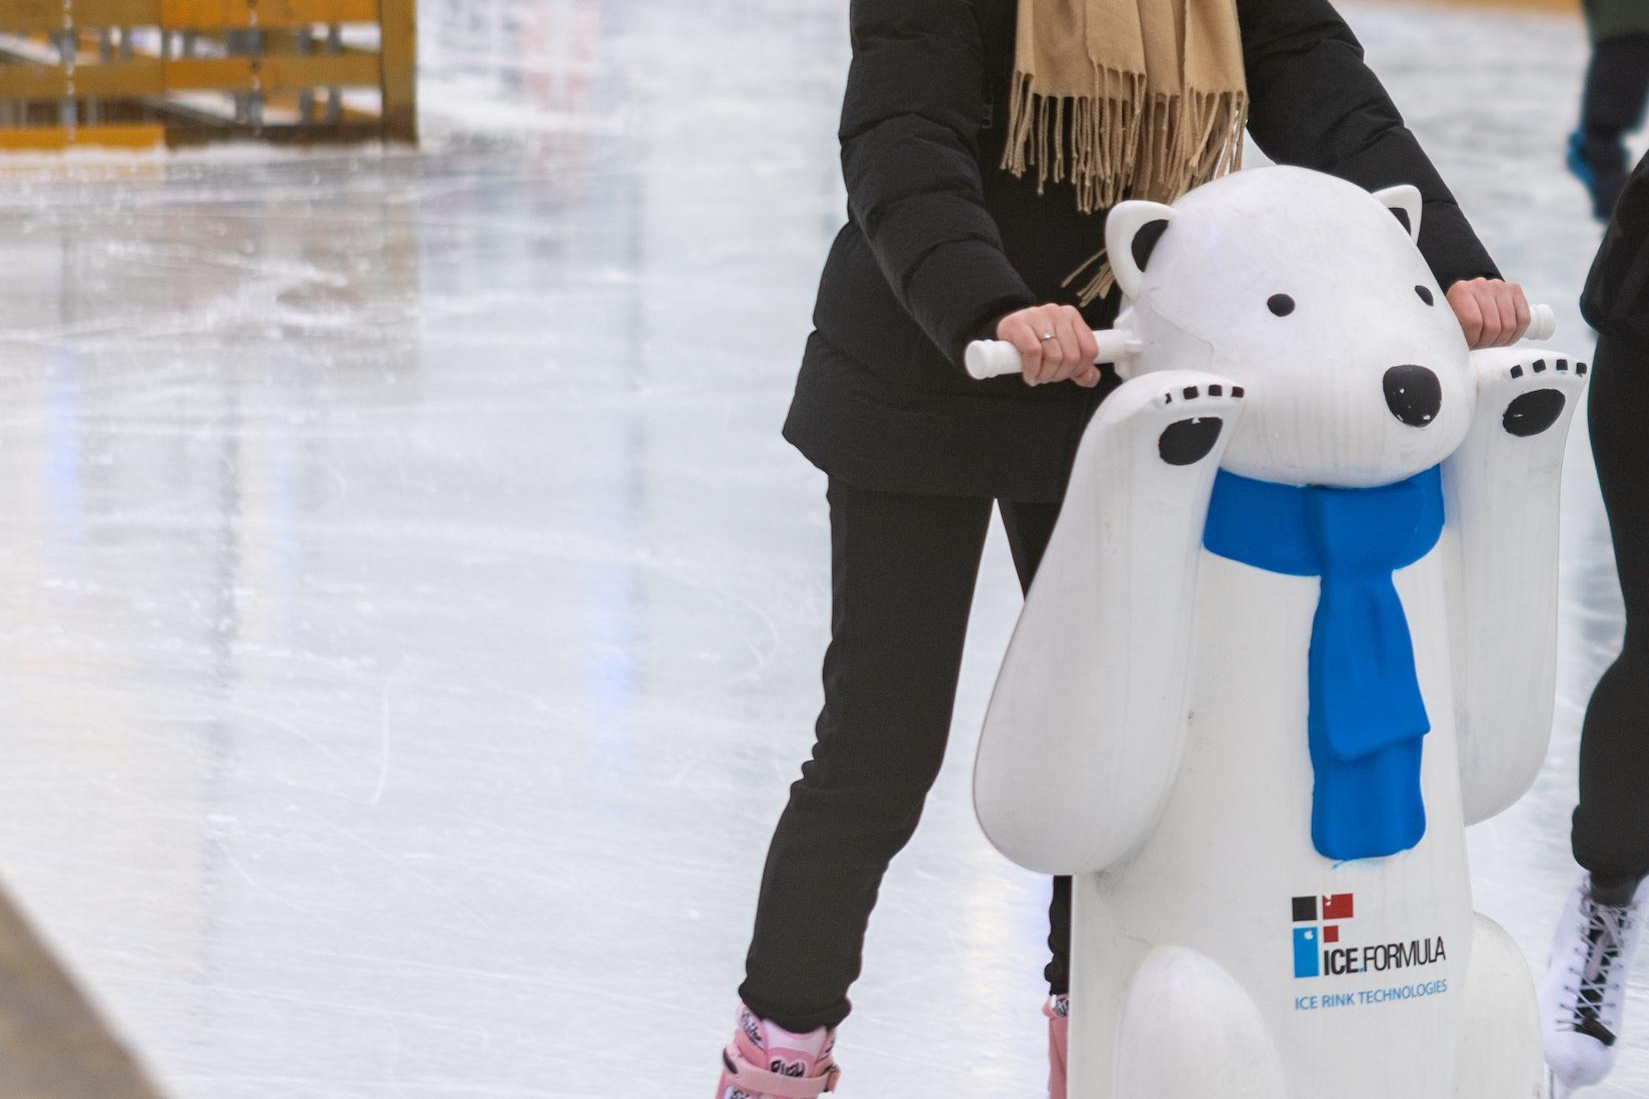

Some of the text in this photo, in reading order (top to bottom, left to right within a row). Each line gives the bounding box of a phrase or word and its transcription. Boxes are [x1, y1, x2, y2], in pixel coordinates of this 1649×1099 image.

[1323, 936, 1447, 976] ICE.FORMULA
[1295, 979, 1448, 1010] ICE RINK TECHNOLOGIES
